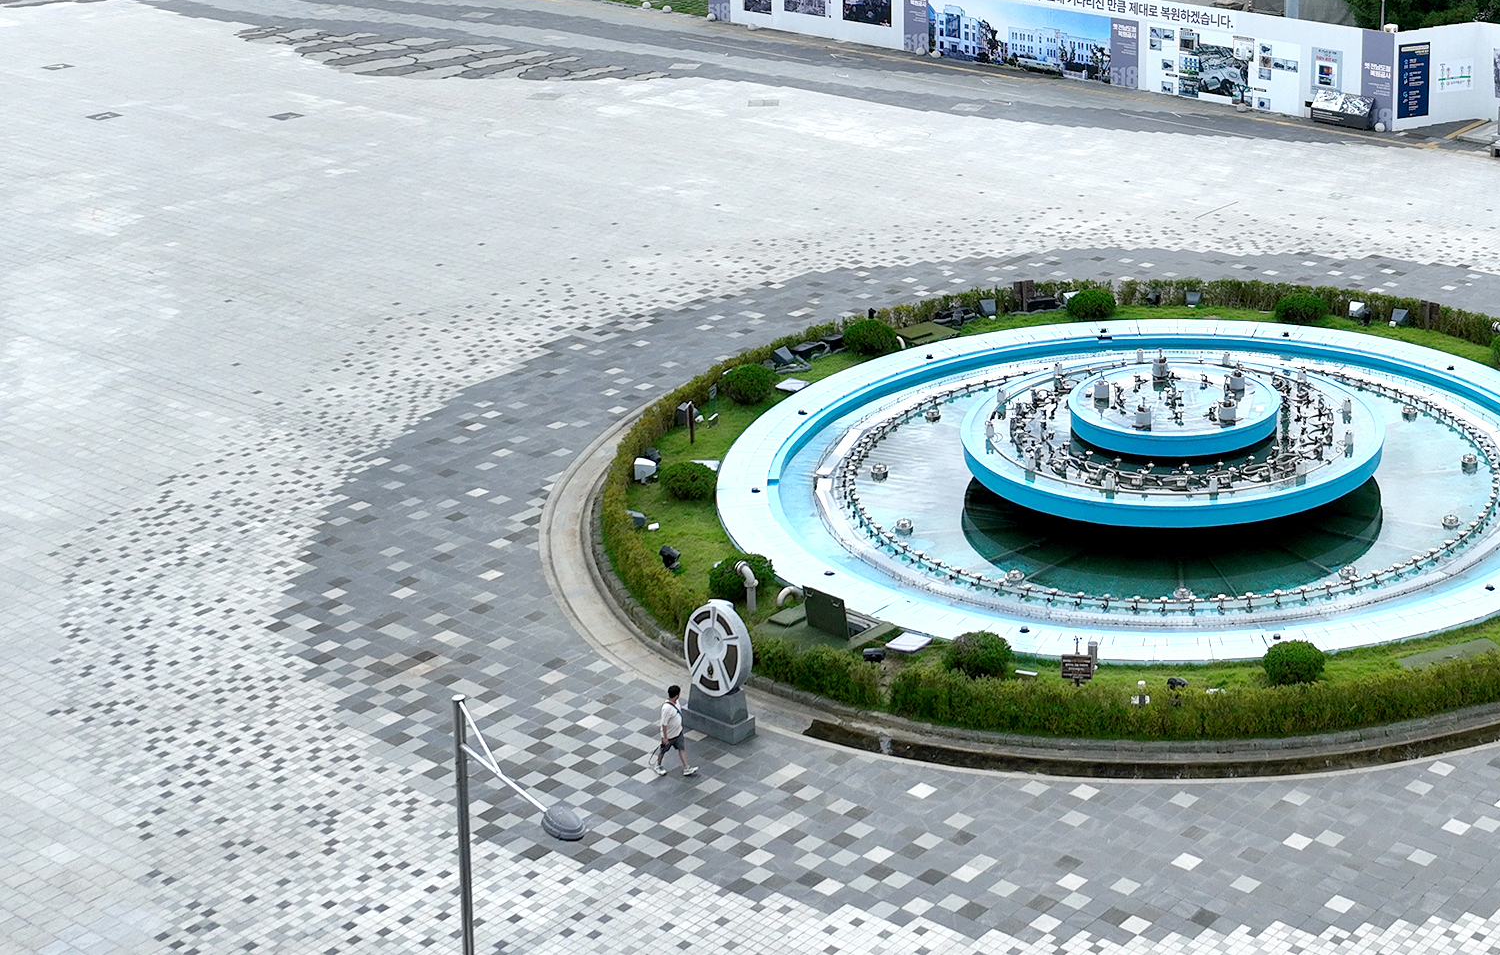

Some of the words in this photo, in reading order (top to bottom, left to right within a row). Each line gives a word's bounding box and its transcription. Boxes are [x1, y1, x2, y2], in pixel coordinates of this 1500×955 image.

[1107, 0, 1126, 14] 만큼
[1128, 2, 1158, 17] 제대로
[1160, 6, 1233, 29] 복원하겠습니다.
[905, 33, 929, 54] 518
[1111, 65, 1138, 90] 518
